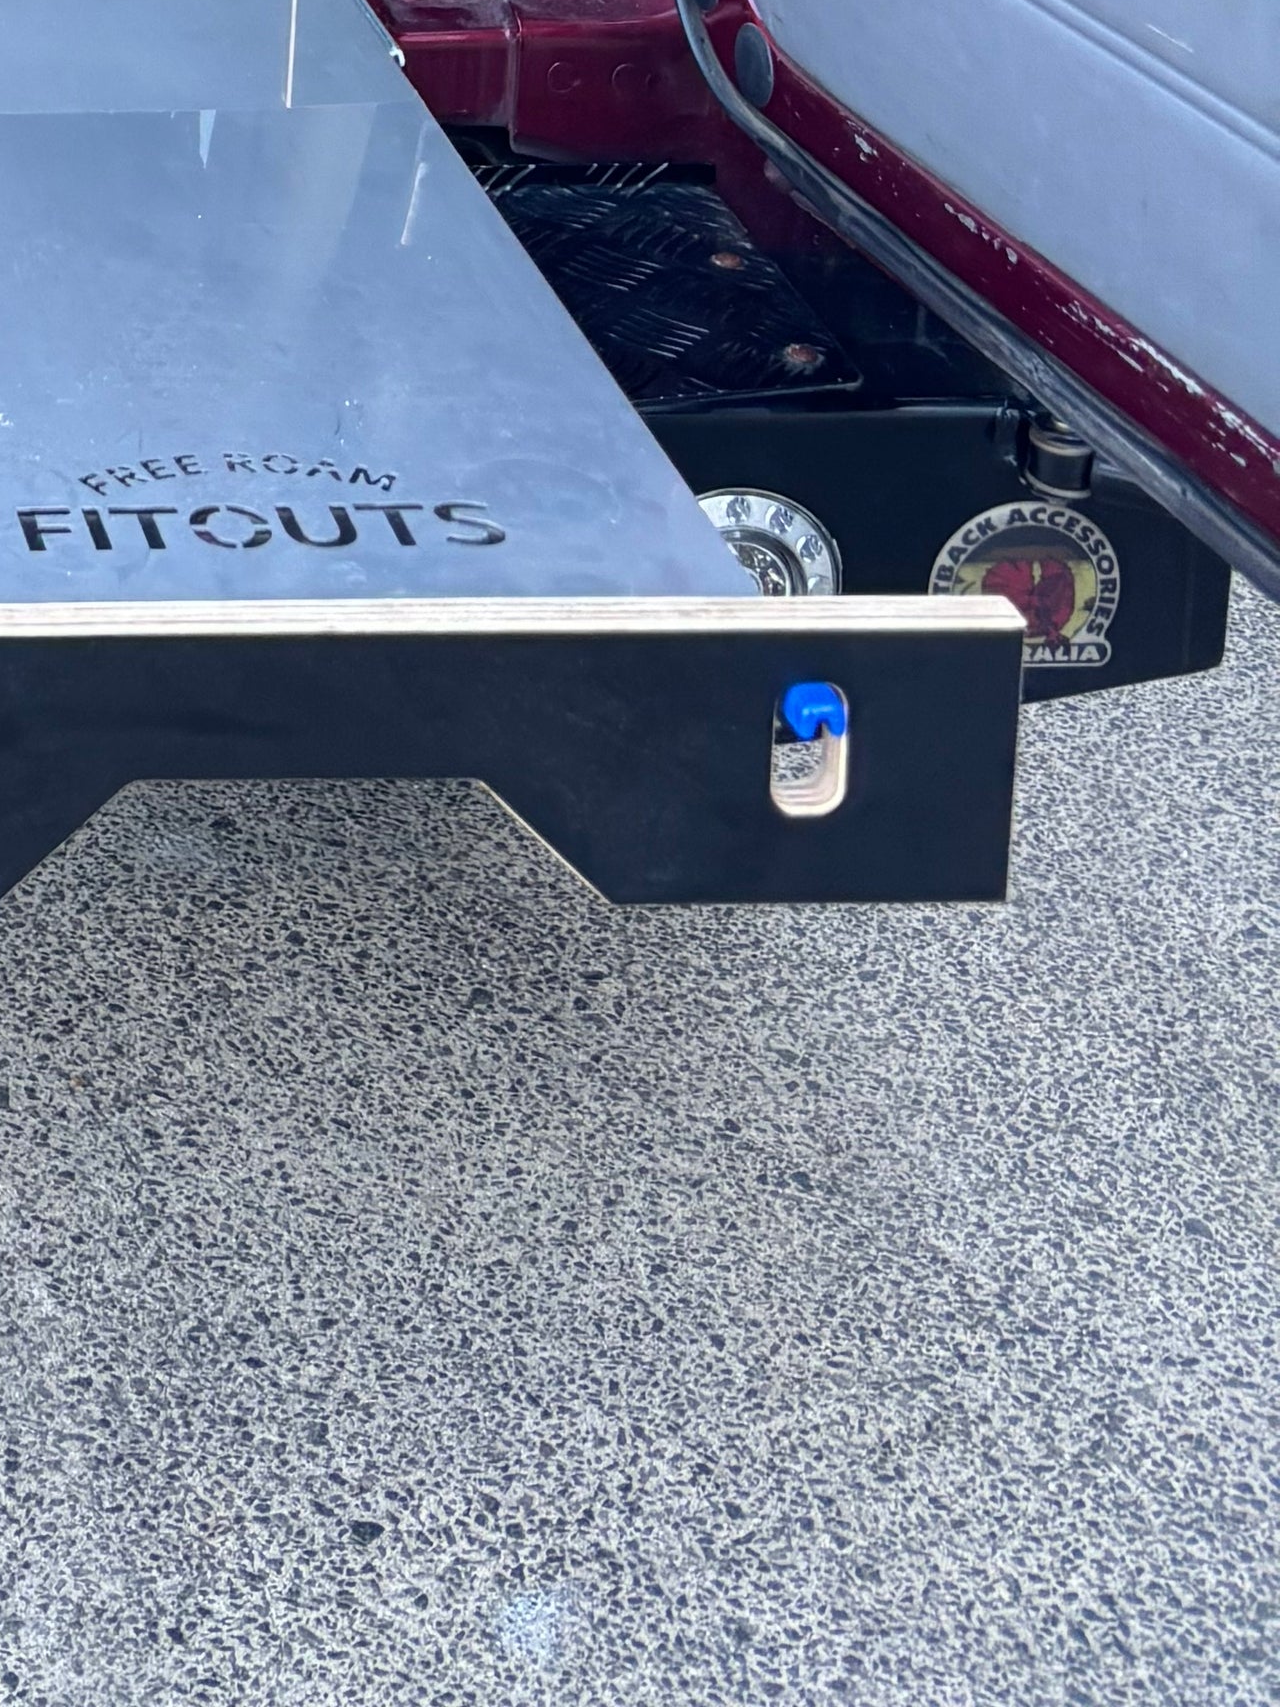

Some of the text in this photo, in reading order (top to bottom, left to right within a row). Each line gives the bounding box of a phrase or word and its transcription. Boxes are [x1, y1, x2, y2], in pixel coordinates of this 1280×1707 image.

[77, 451, 398, 497] FREE ROAM
[15, 499, 507, 552] FITOUTS
[933, 506, 1118, 637] TBACK ACCESSORIES
